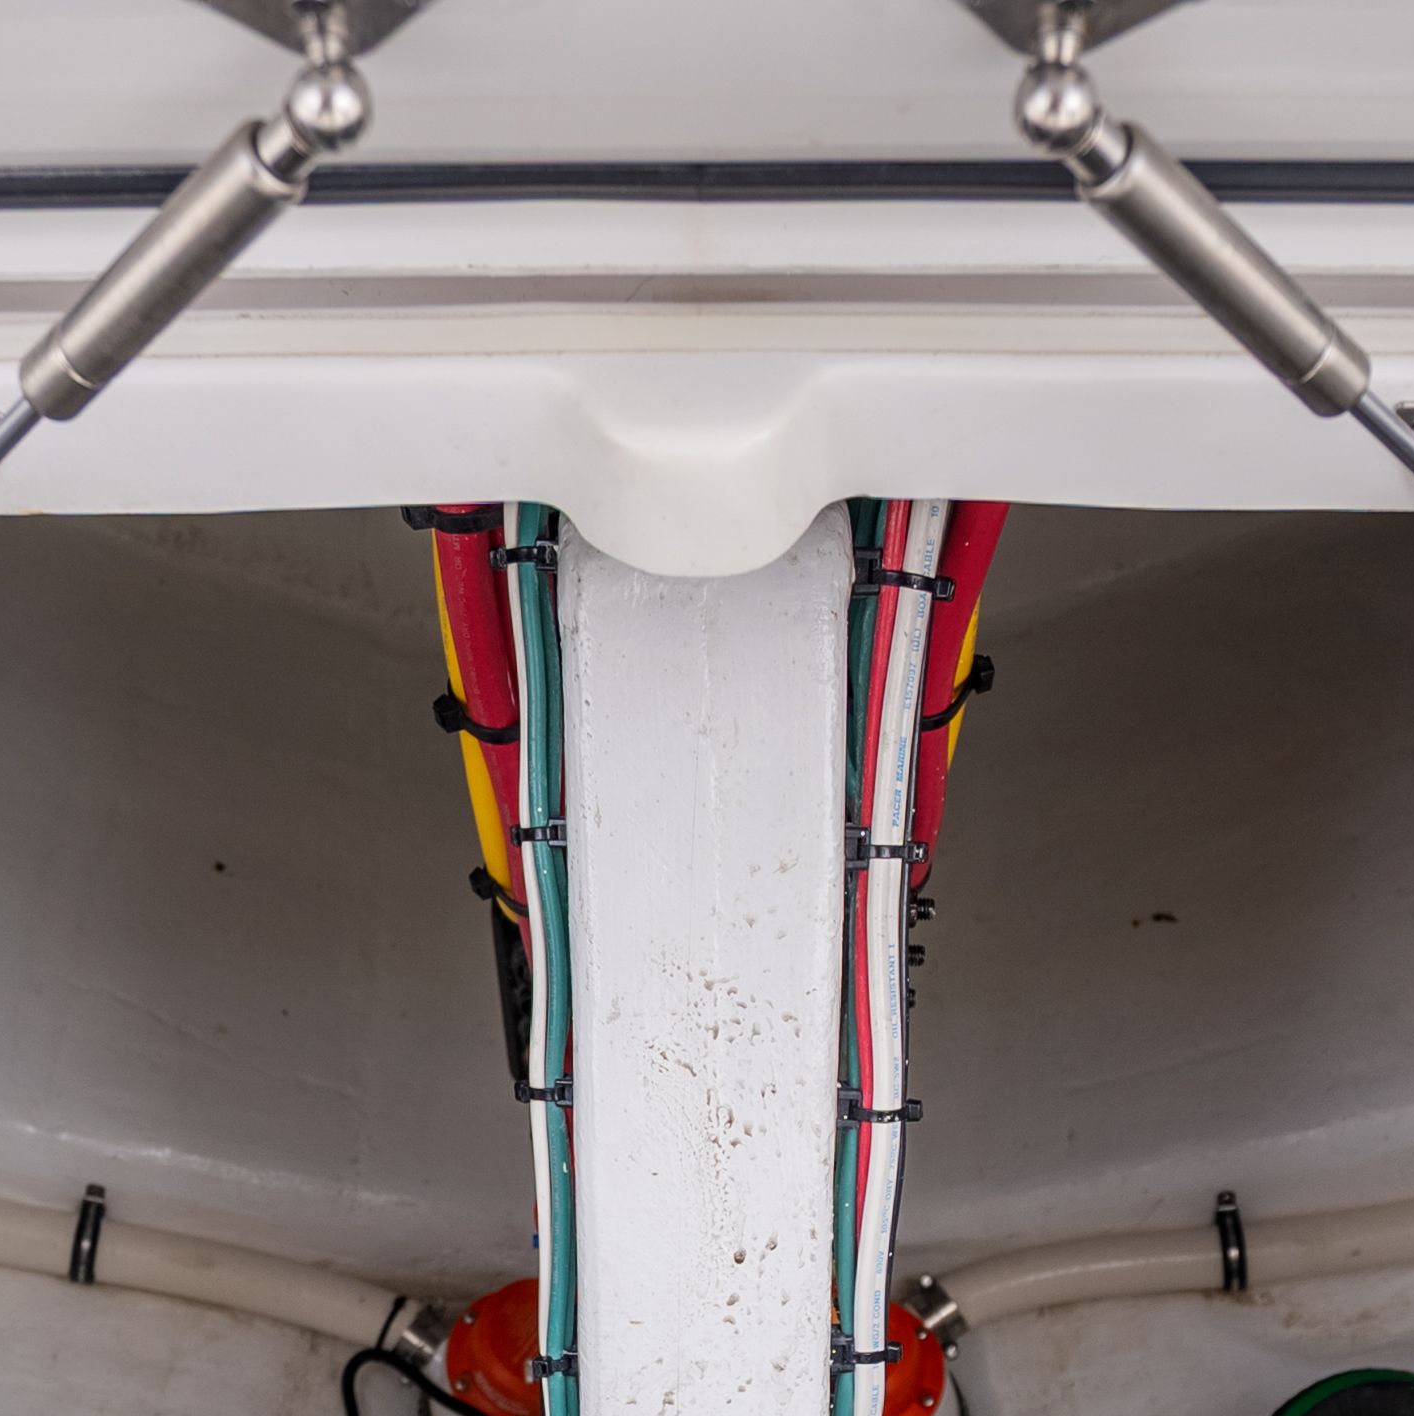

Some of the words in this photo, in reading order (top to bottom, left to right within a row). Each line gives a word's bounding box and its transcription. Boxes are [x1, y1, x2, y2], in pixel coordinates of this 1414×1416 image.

[916, 592, 928, 619] BOA
[895, 736, 908, 783] MARINE
[892, 788, 903, 828] PACER
[887, 955, 898, 1017] RESISTANT
[891, 1021, 899, 1039] OIL
[871, 1384, 881, 1413] CABLE
